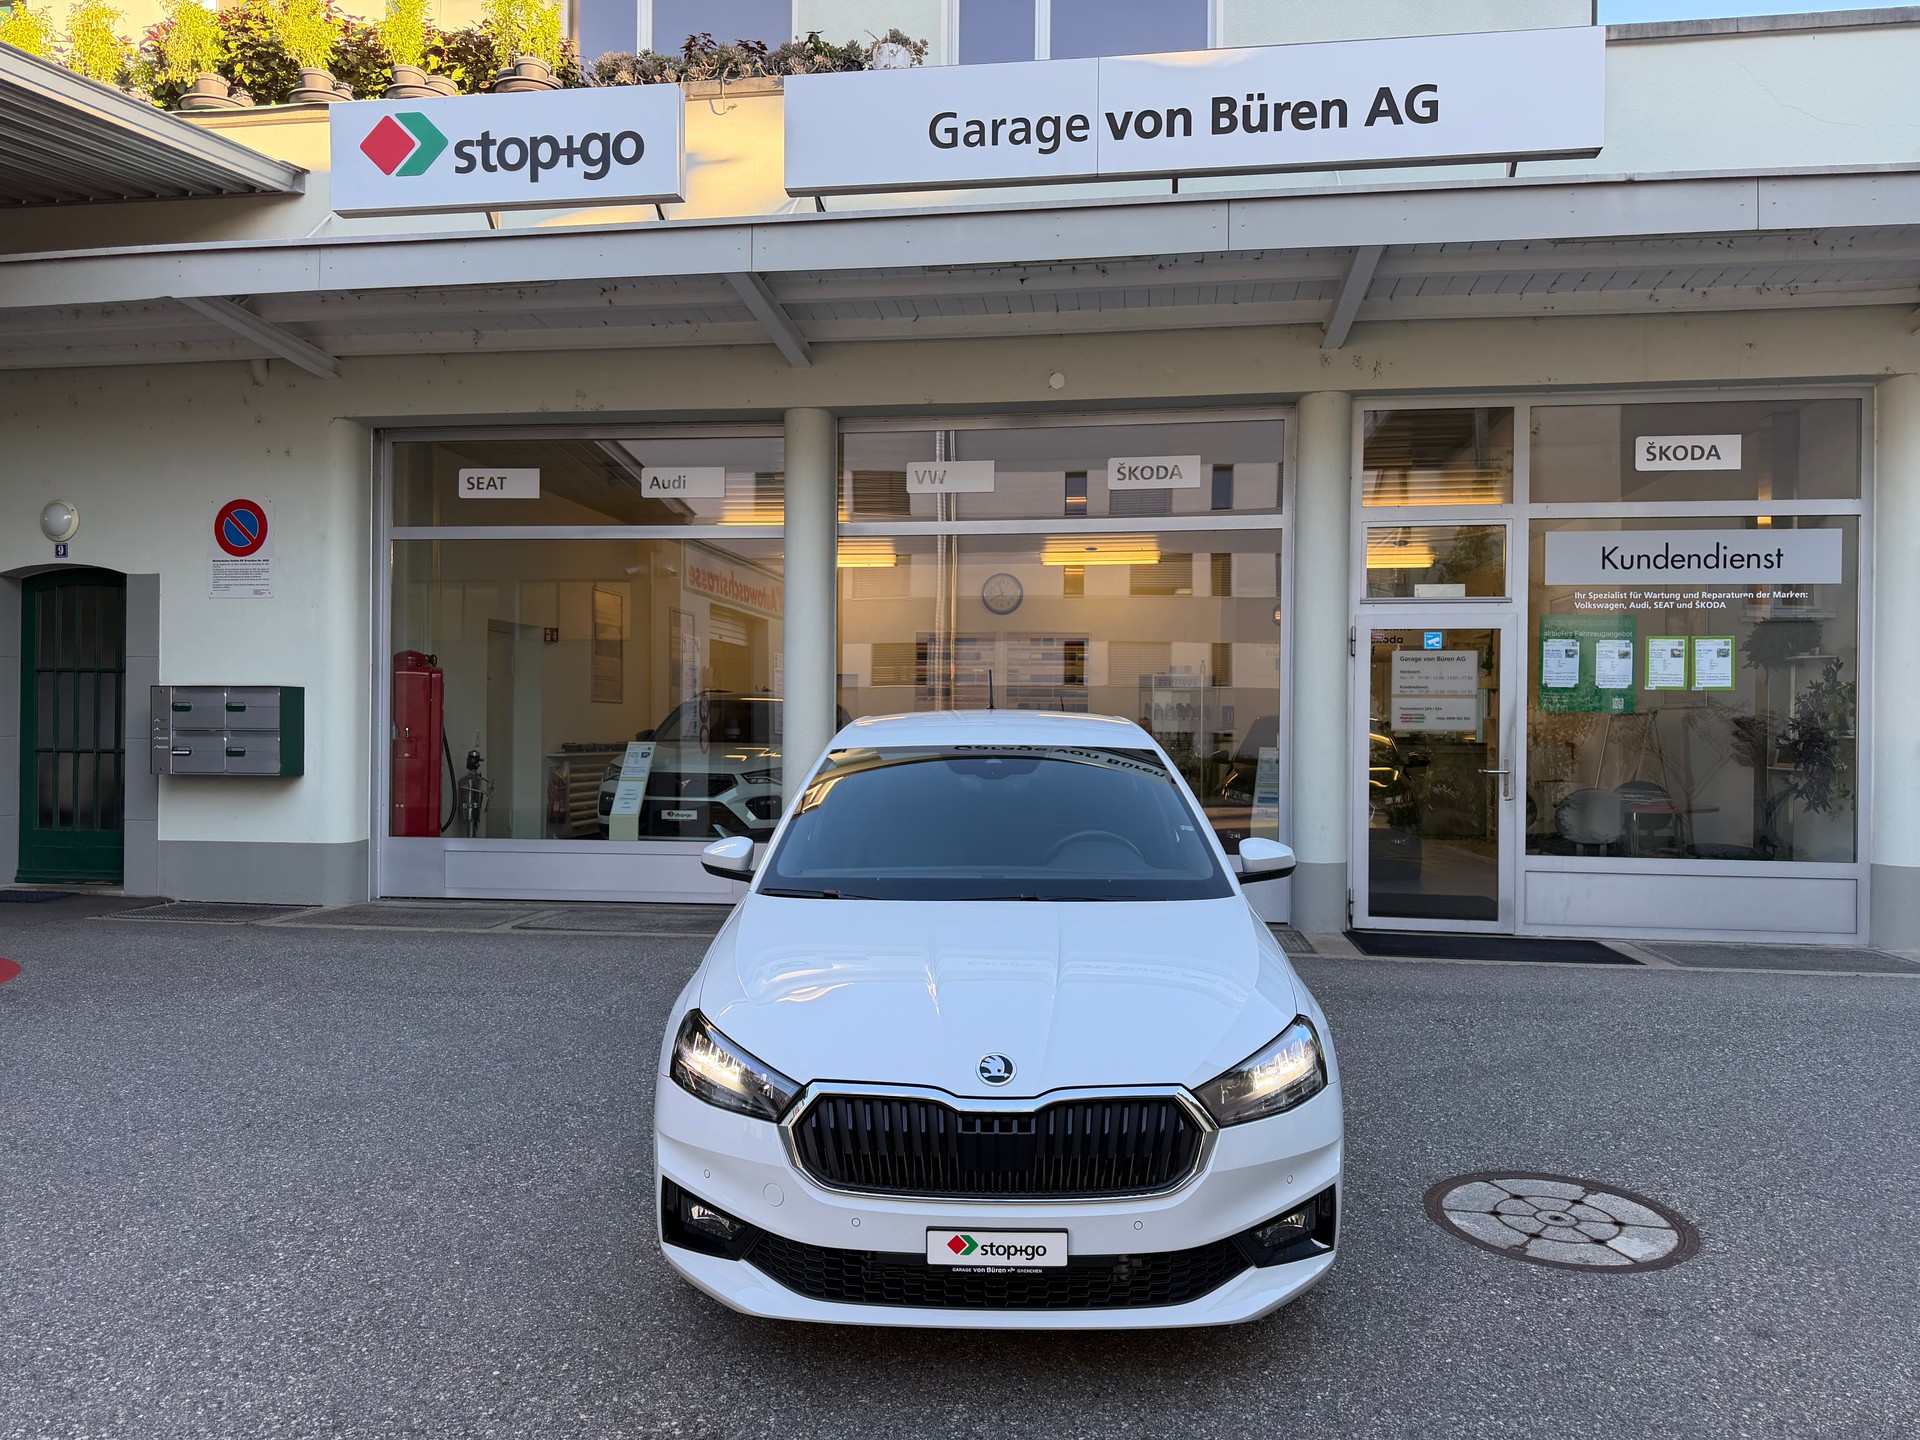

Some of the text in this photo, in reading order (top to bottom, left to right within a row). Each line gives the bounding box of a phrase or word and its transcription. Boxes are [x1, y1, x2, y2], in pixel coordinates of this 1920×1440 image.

[928, 83, 1439, 155] Garage von Büren AG
[453, 129, 645, 183] stop+go
[1645, 440, 1722, 463] ŠKODA
[914, 469, 948, 485] VW
[1116, 462, 1184, 482] ŠKODA
[466, 476, 507, 491] SEAT
[649, 475, 687, 490] Audi
[58, 545, 64, 555] 9
[1600, 542, 1785, 571] Kundendienst
[1574, 592, 1587, 600] Ihr
[1588, 591, 1627, 601] Spezialist
[1629, 591, 1643, 600] für
[1644, 591, 1681, 602] Wartung
[1683, 591, 1699, 600] und
[1701, 591, 1754, 601] Reparaturen
[1756, 591, 1771, 599] der
[1574, 601, 1627, 611] Volkswagen,
[1629, 601, 1651, 610] Audi,
[1676, 601, 1693, 609] und
[1695, 600, 1727, 609] ŠKODA
[1574, 630, 1633, 638] Fahrzeugangebot
[980, 1242, 1047, 1261] stop+go
[986, 1266, 1007, 1274] Büren
